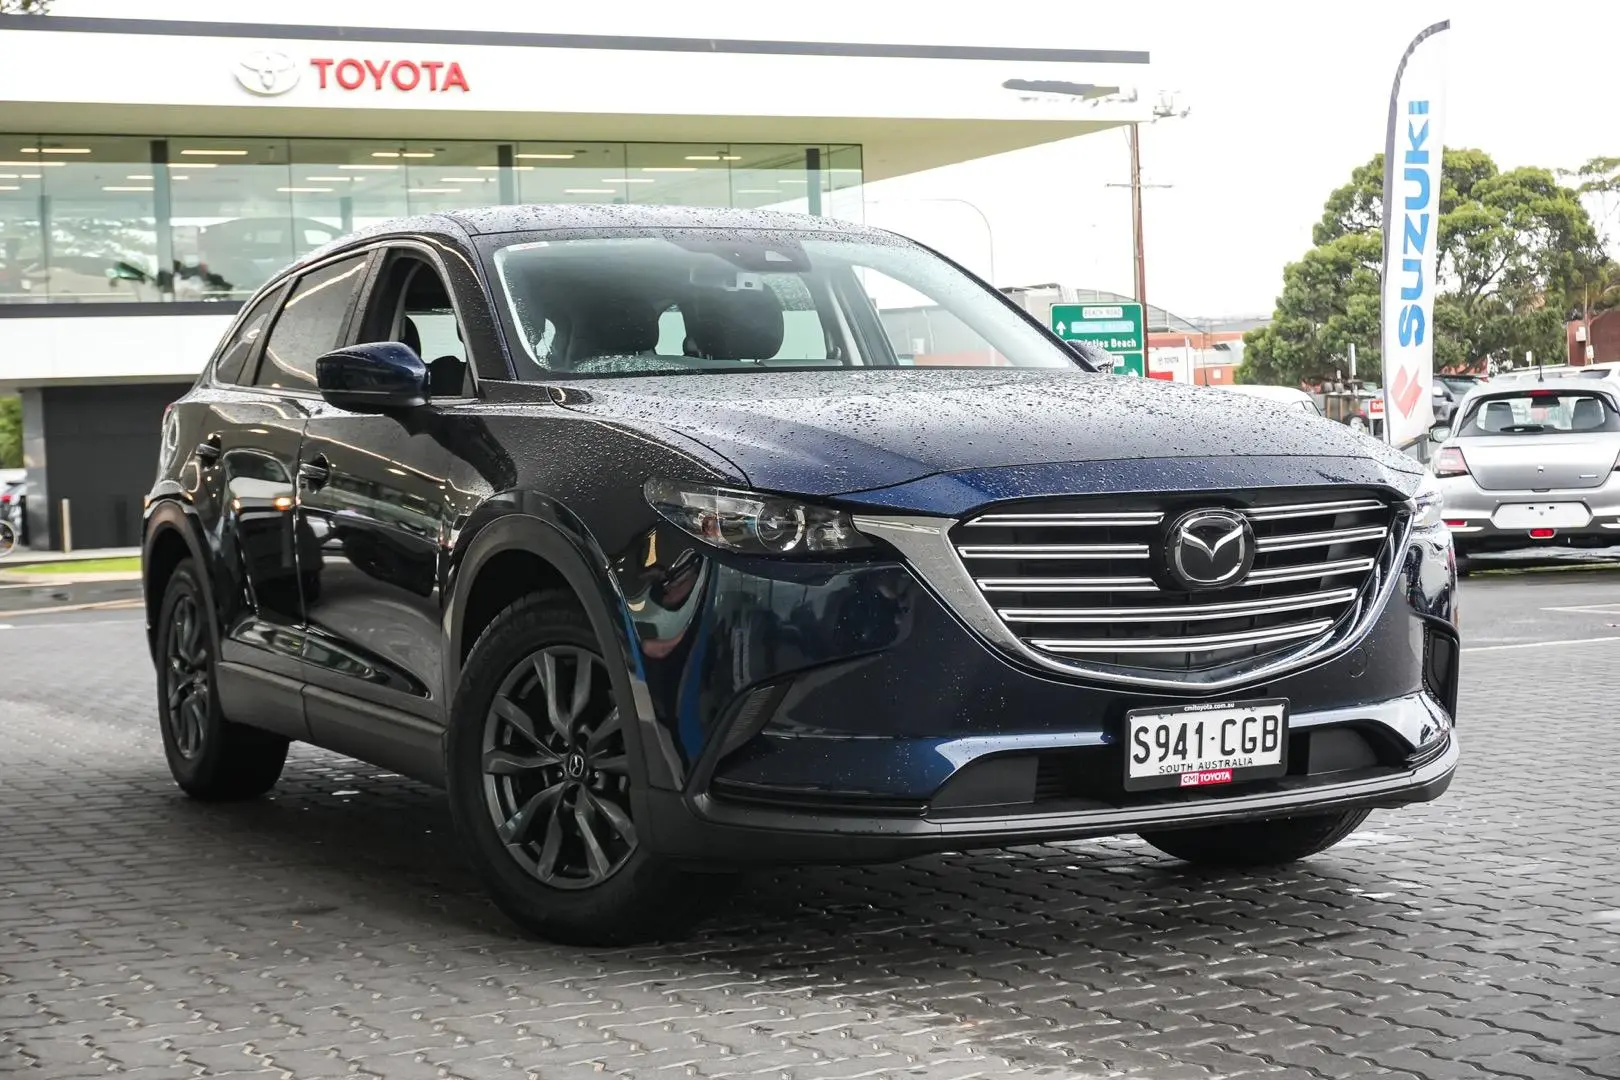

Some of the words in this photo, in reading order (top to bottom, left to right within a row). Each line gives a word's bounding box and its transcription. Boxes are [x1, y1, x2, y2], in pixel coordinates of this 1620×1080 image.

[310, 58, 470, 91] TOYOTA
[1398, 100, 1430, 347] SUZUKI
[1111, 338, 1137, 348] Beach
[1184, 702, 1235, 712] cmitoyota.com.au
[1159, 763, 1193, 774] SOUTH
[1198, 757, 1253, 770] AUSTRALIA
[1200, 771, 1231, 782] TOYOTA
